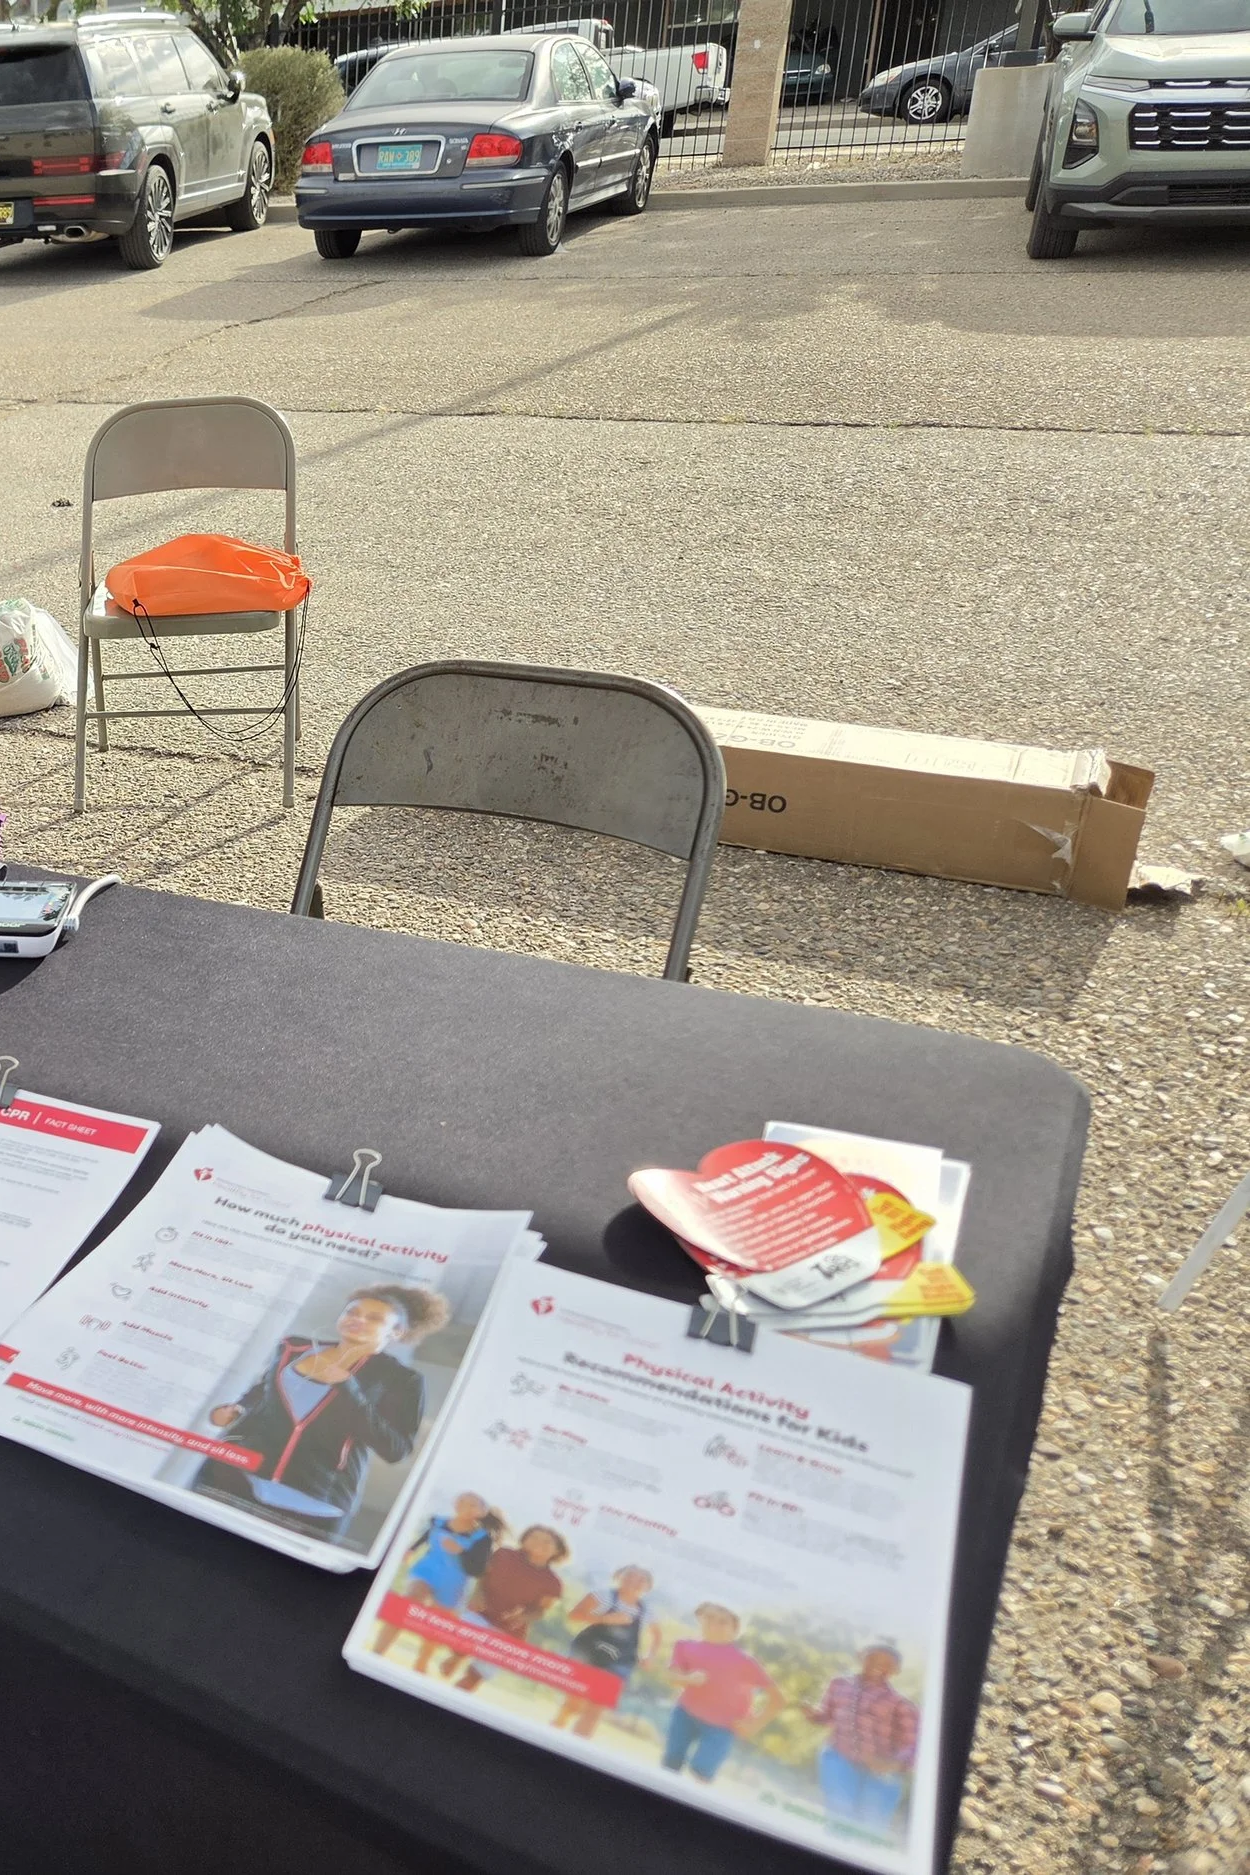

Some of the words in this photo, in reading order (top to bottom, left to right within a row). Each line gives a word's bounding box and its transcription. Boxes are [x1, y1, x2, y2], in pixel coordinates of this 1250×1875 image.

[0, 1105, 31, 1121] CPR
[44, 1116, 68, 1130] FACT
[67, 1120, 97, 1137] SHEET
[214, 1195, 252, 1215] How
[254, 1207, 300, 1227] much
[301, 1220, 377, 1249] physical
[378, 1241, 450, 1264] activity
[264, 1221, 286, 1237] do
[287, 1228, 323, 1246] you
[323, 1234, 382, 1260] need?
[564, 1351, 772, 1426] Recommendations
[776, 1412, 815, 1434] for
[815, 1424, 871, 1453] Kids
[623, 1352, 715, 1391] Physical
[719, 1380, 811, 1420] Activity
[27, 1380, 53, 1397] Move
[84, 1396, 110, 1415] with
[109, 1407, 135, 1426] more
[186, 1434, 211, 1452] and
[457, 1620, 486, 1643] and
[489, 1632, 529, 1656] move
